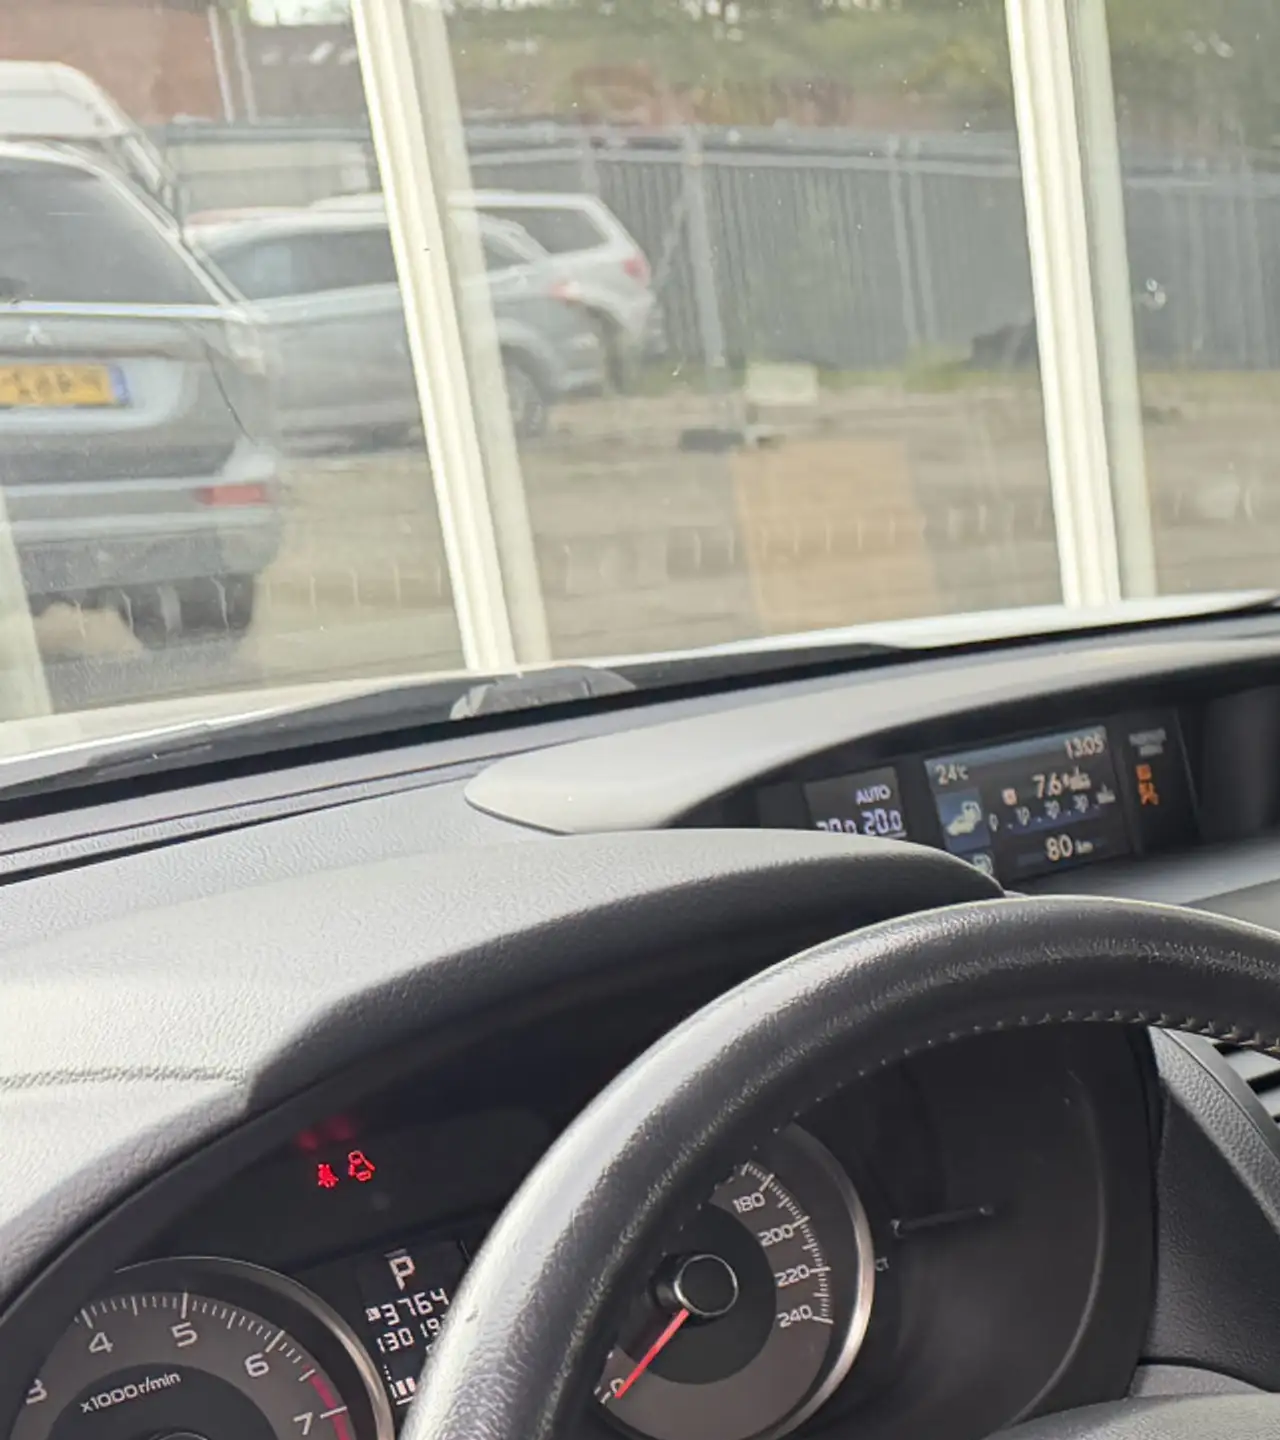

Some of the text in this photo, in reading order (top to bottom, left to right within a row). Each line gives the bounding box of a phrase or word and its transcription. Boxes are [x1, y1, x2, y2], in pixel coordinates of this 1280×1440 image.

[855, 783, 891, 805] AUTO
[1045, 833, 1073, 862] 80
[732, 1192, 766, 1214] 180
[758, 1223, 795, 1248] 200
[388, 1255, 416, 1291] P
[774, 1264, 810, 1287] 220
[776, 1304, 813, 1329] 240
[88, 1331, 114, 1354] 4
[170, 1321, 199, 1348] 5
[243, 1352, 270, 1378] 6
[292, 1411, 314, 1436] 7
